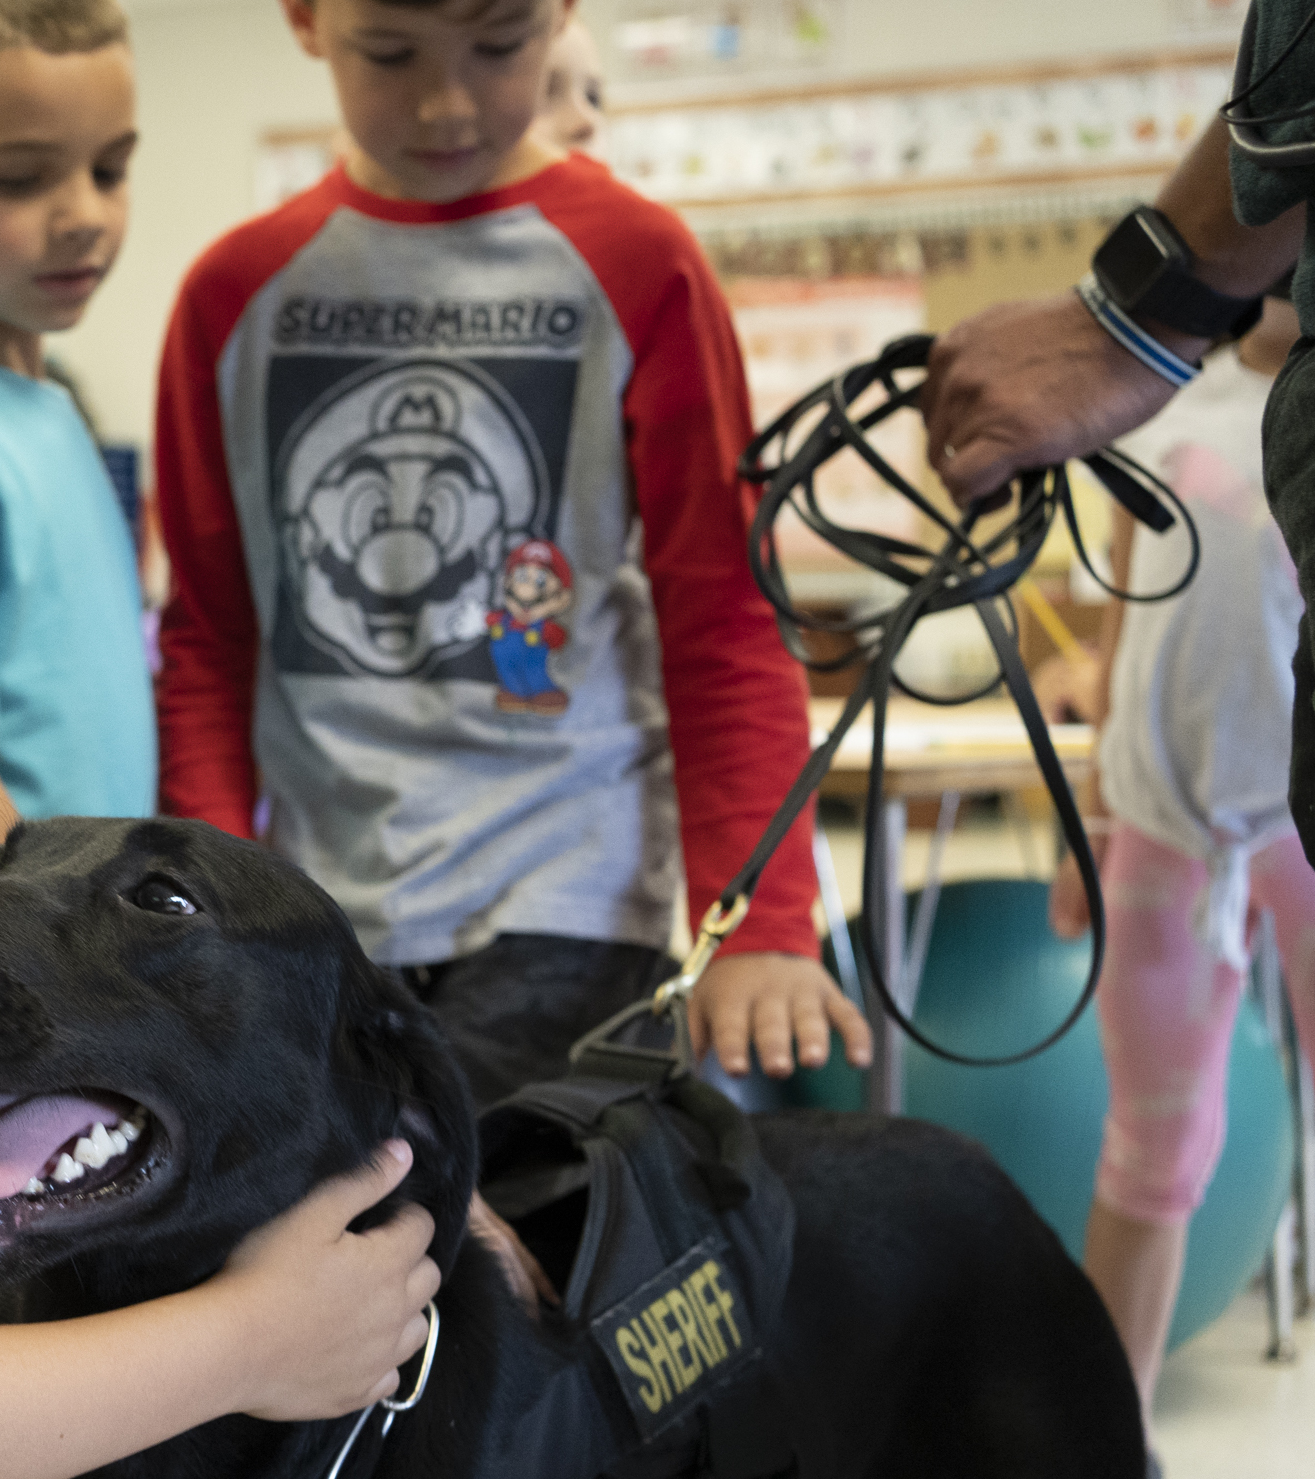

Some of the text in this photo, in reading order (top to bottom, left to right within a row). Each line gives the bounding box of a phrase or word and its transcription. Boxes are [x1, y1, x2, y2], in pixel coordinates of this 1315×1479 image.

[276, 296, 582, 345] SUPER MARIO
[615, 1259, 743, 1415] SHERIFF
